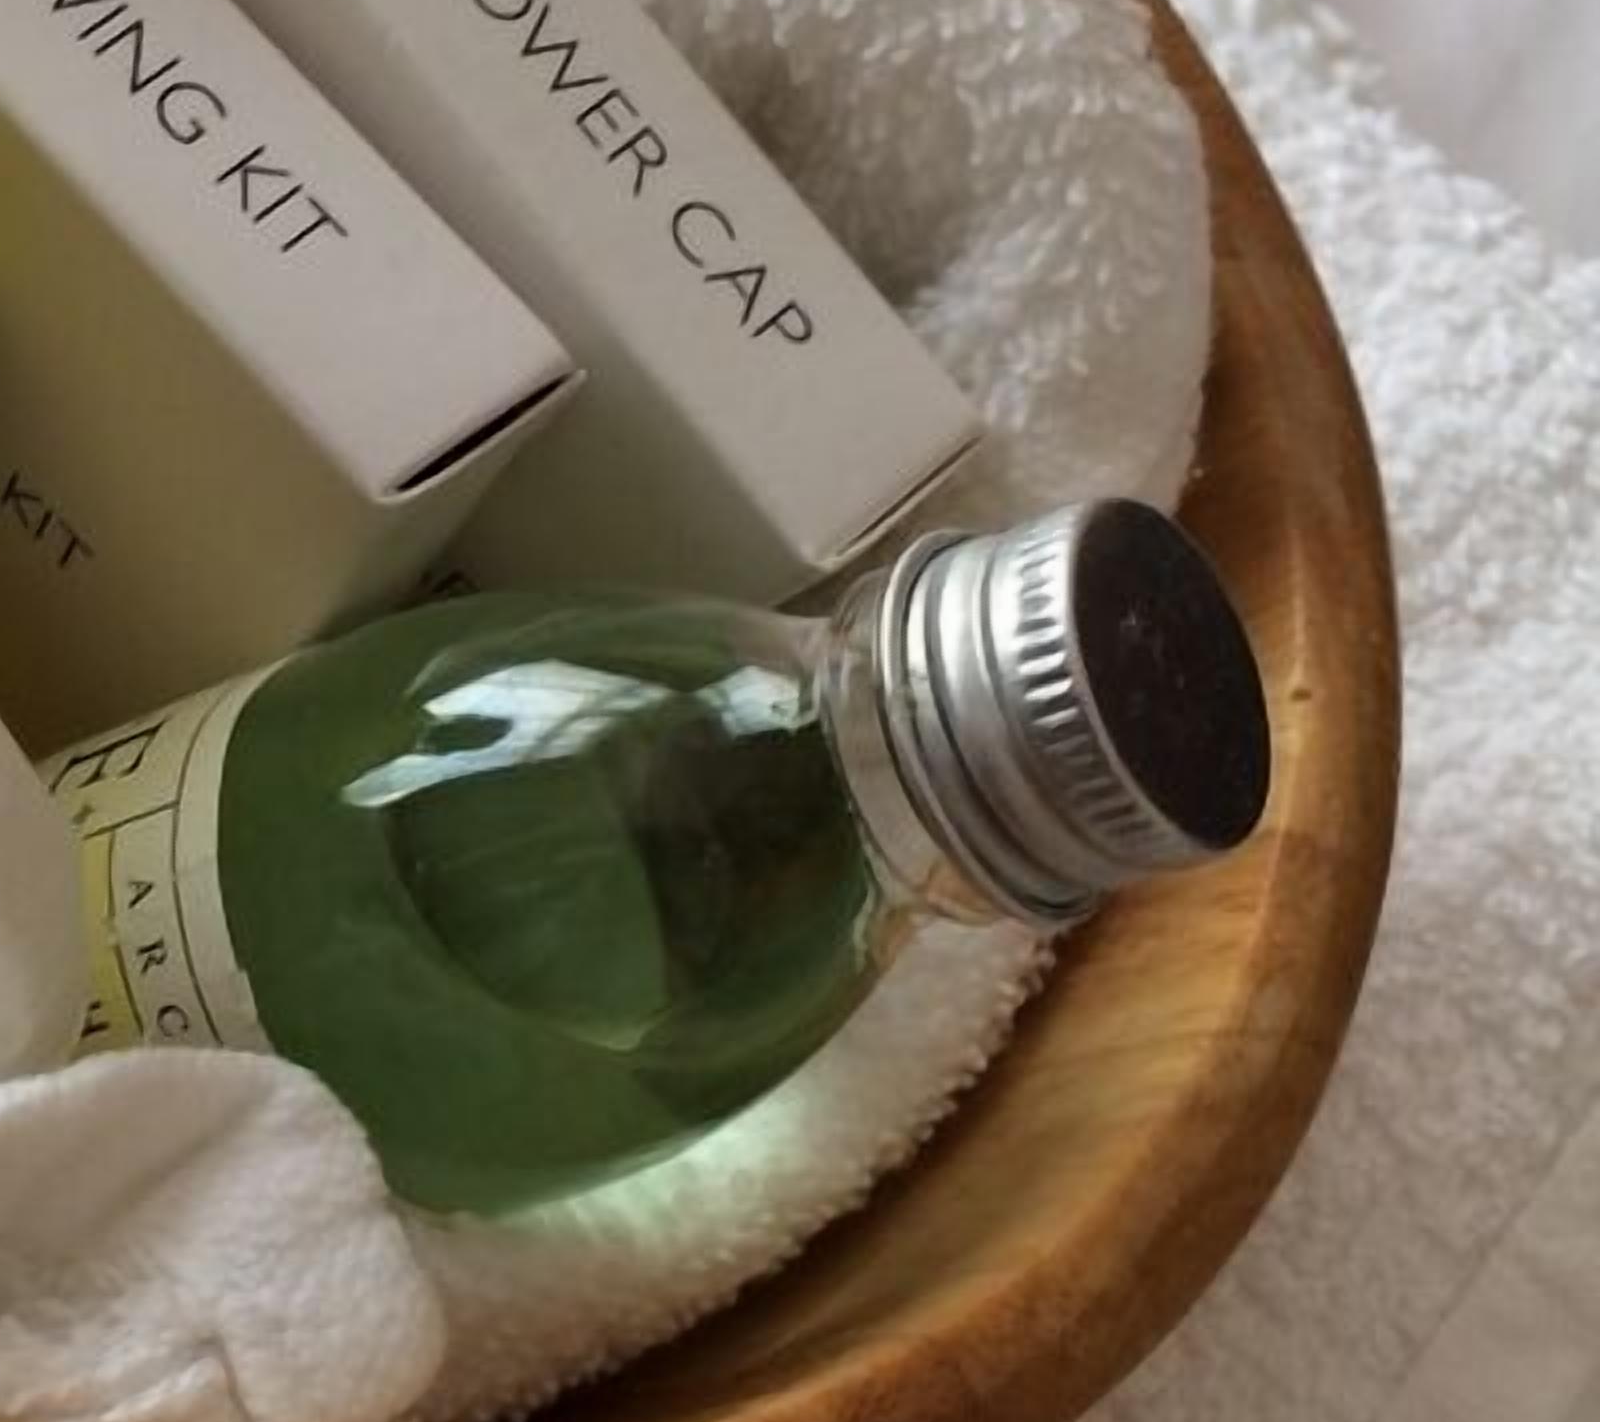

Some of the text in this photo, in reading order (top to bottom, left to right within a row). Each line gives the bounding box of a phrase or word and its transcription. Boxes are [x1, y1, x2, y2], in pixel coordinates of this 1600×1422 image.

[215, 145, 349, 253] KIT
[670, 201, 813, 346] CAP
[0, 470, 94, 569] KIT
